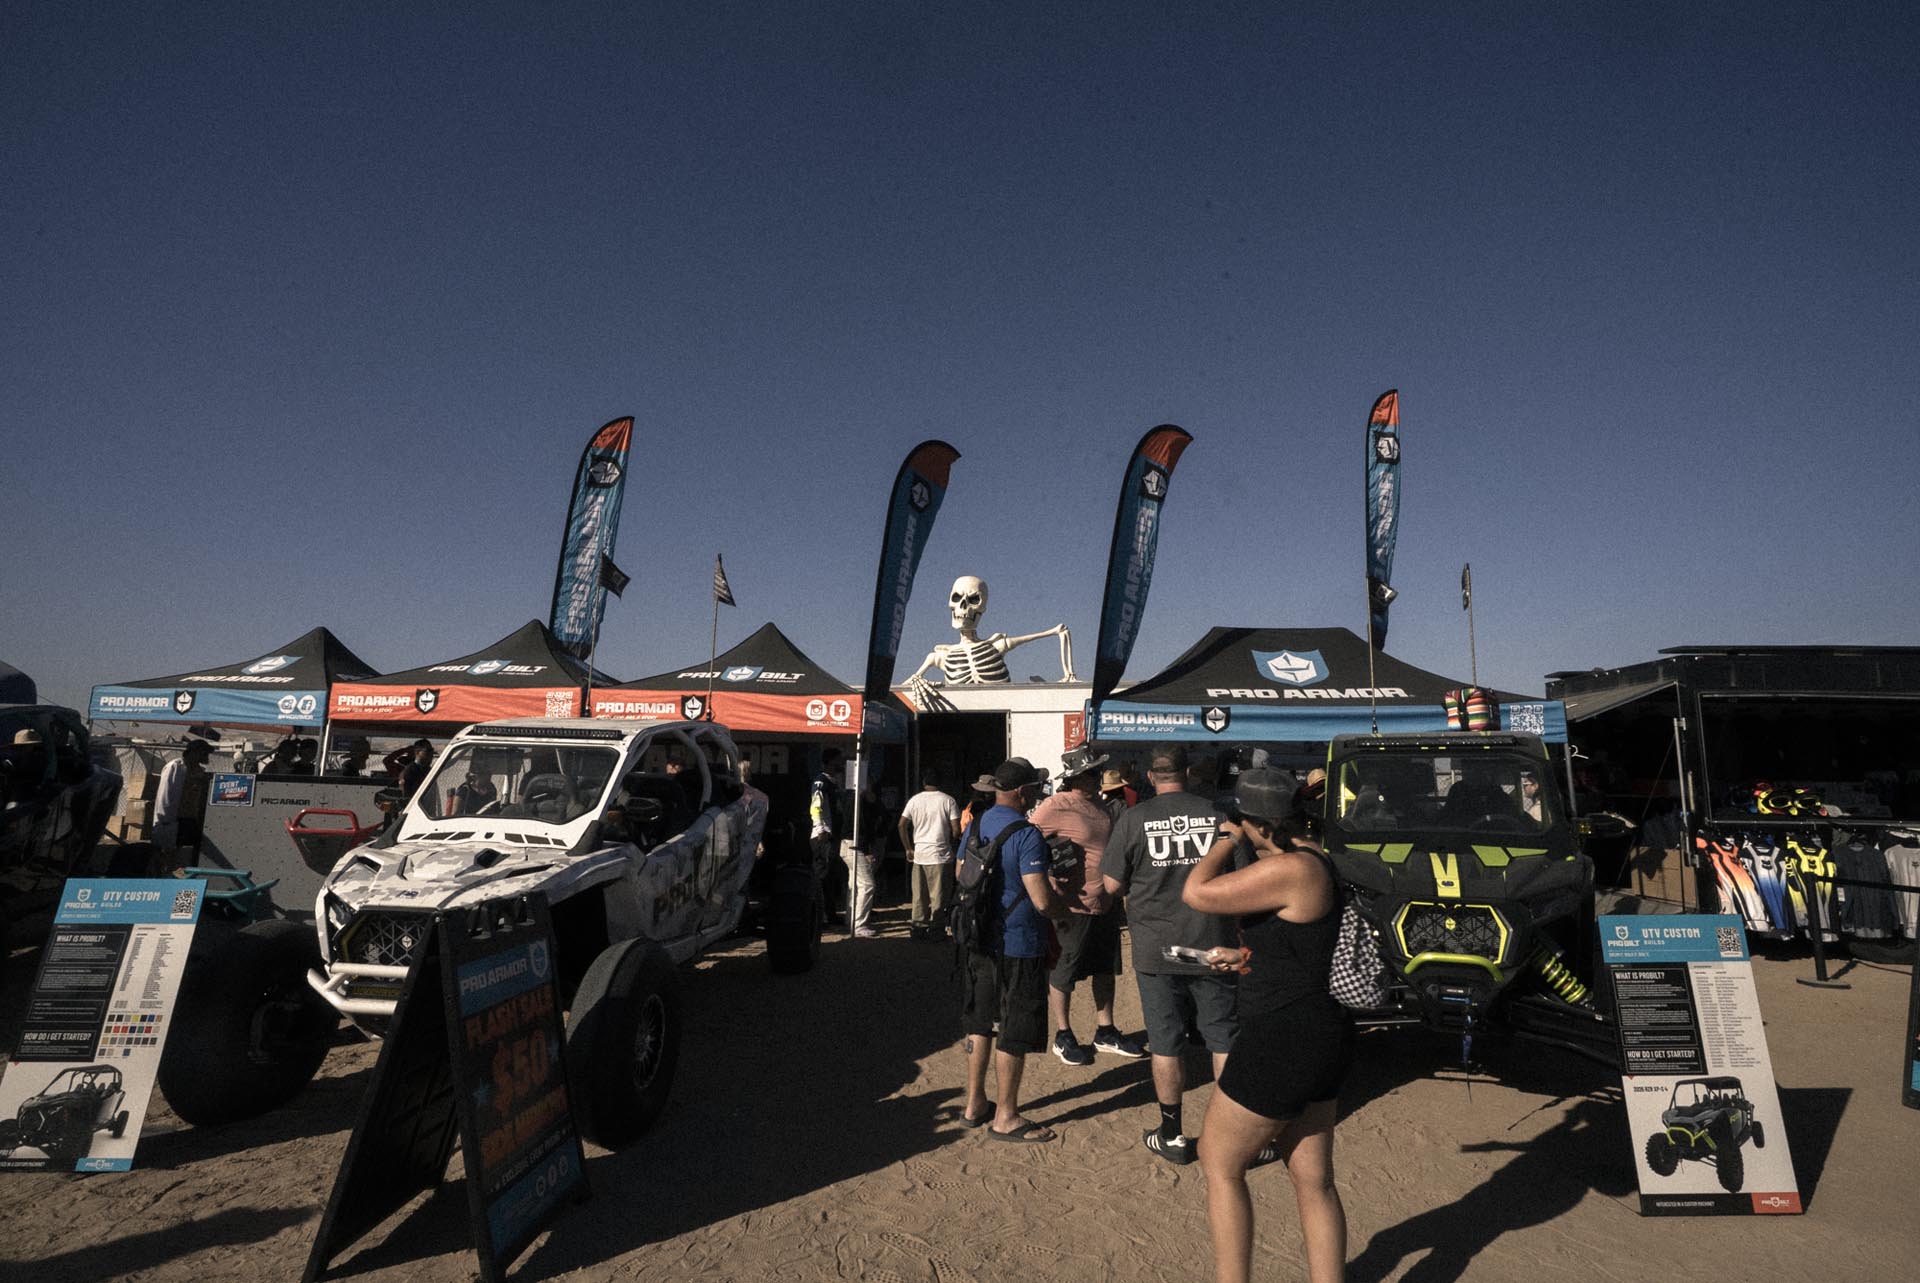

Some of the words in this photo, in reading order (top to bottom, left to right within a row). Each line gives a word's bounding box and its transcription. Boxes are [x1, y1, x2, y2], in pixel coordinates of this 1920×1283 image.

[896, 514, 917, 602] ARMOR
[1125, 506, 1155, 601] ARMOR
[428, 664, 470, 672] PRO
[501, 664, 547, 673] BILT
[227, 675, 295, 683] ARMOR
[677, 671, 720, 679] PRO
[755, 672, 807, 681] BILT
[1206, 688, 1281, 699] PRO
[1284, 687, 1410, 700] ARMOR
[100, 697, 124, 707] PRO
[125, 697, 169, 708] ARMOR
[338, 695, 364, 706] PRO
[364, 696, 411, 707] ARMOR
[596, 702, 625, 713] PRO
[626, 702, 675, 714] ARMOR
[1101, 713, 1136, 725] PRO
[1136, 713, 1195, 725] ARMOR
[219, 780, 240, 790] EVENT
[224, 785, 248, 794] PROMO
[280, 798, 311, 806] ARMOR
[1144, 819, 1171, 832] PRO
[1189, 816, 1217, 827] BILT
[1147, 832, 1215, 861] UTV
[103, 890, 121, 901] UTV
[124, 891, 161, 902] CUSTOM
[56, 934, 73, 943] WHAT
[72, 934, 80, 943] IS
[1642, 928, 1660, 938] UTV
[1663, 928, 1701, 938] CUSTOM
[460, 973, 487, 995] PRO
[485, 957, 528, 987] ARMOR
[1615, 972, 1631, 980] WHAT
[1638, 972, 1665, 980] PROBILT?
[24, 1033, 37, 1041] HOW
[38, 1033, 47, 1041] DO
[50, 1033, 61, 1041] GET
[62, 1033, 92, 1041] STARTED?
[1627, 1050, 1641, 1058] HOW
[1641, 1050, 1650, 1058] DO
[1653, 1050, 1666, 1058] GET
[1666, 1050, 1696, 1058] STARTED?
[493, 1029, 550, 1119] $50
